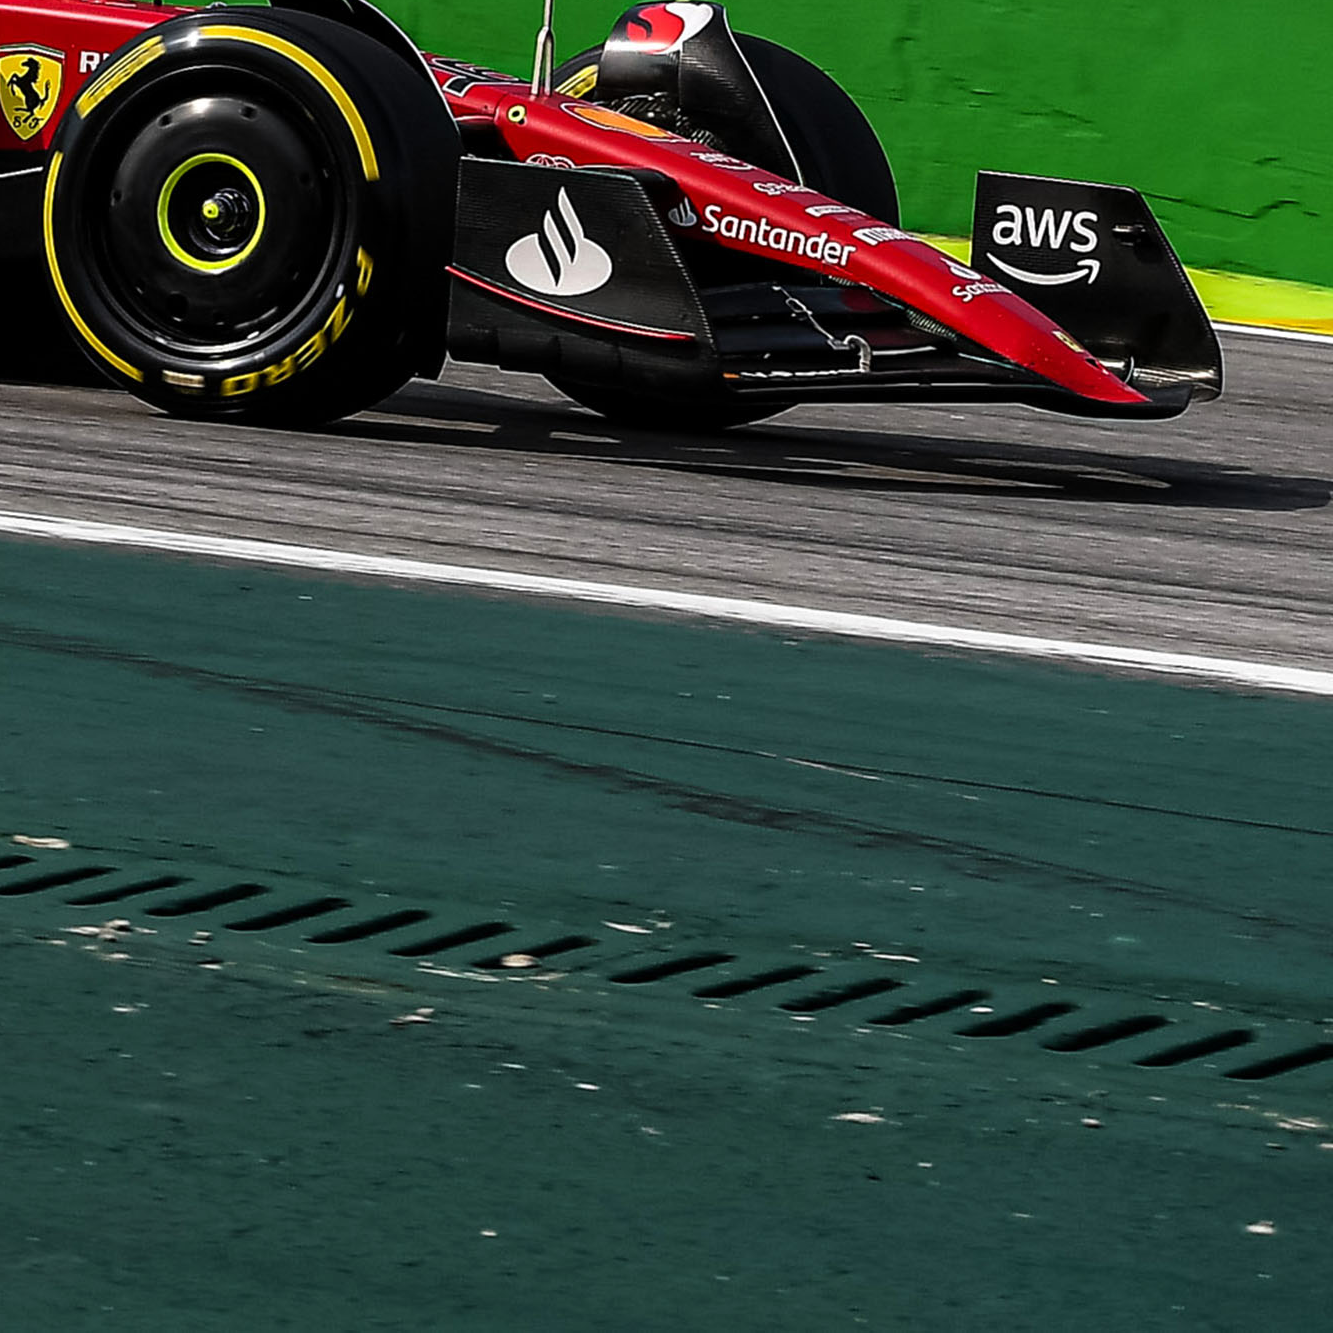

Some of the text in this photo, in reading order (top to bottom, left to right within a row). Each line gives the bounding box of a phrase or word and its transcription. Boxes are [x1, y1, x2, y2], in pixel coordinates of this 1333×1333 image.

[701, 204, 856, 266] Santander
[992, 203, 1099, 253] aws
[220, 295, 355, 397] ZERO
